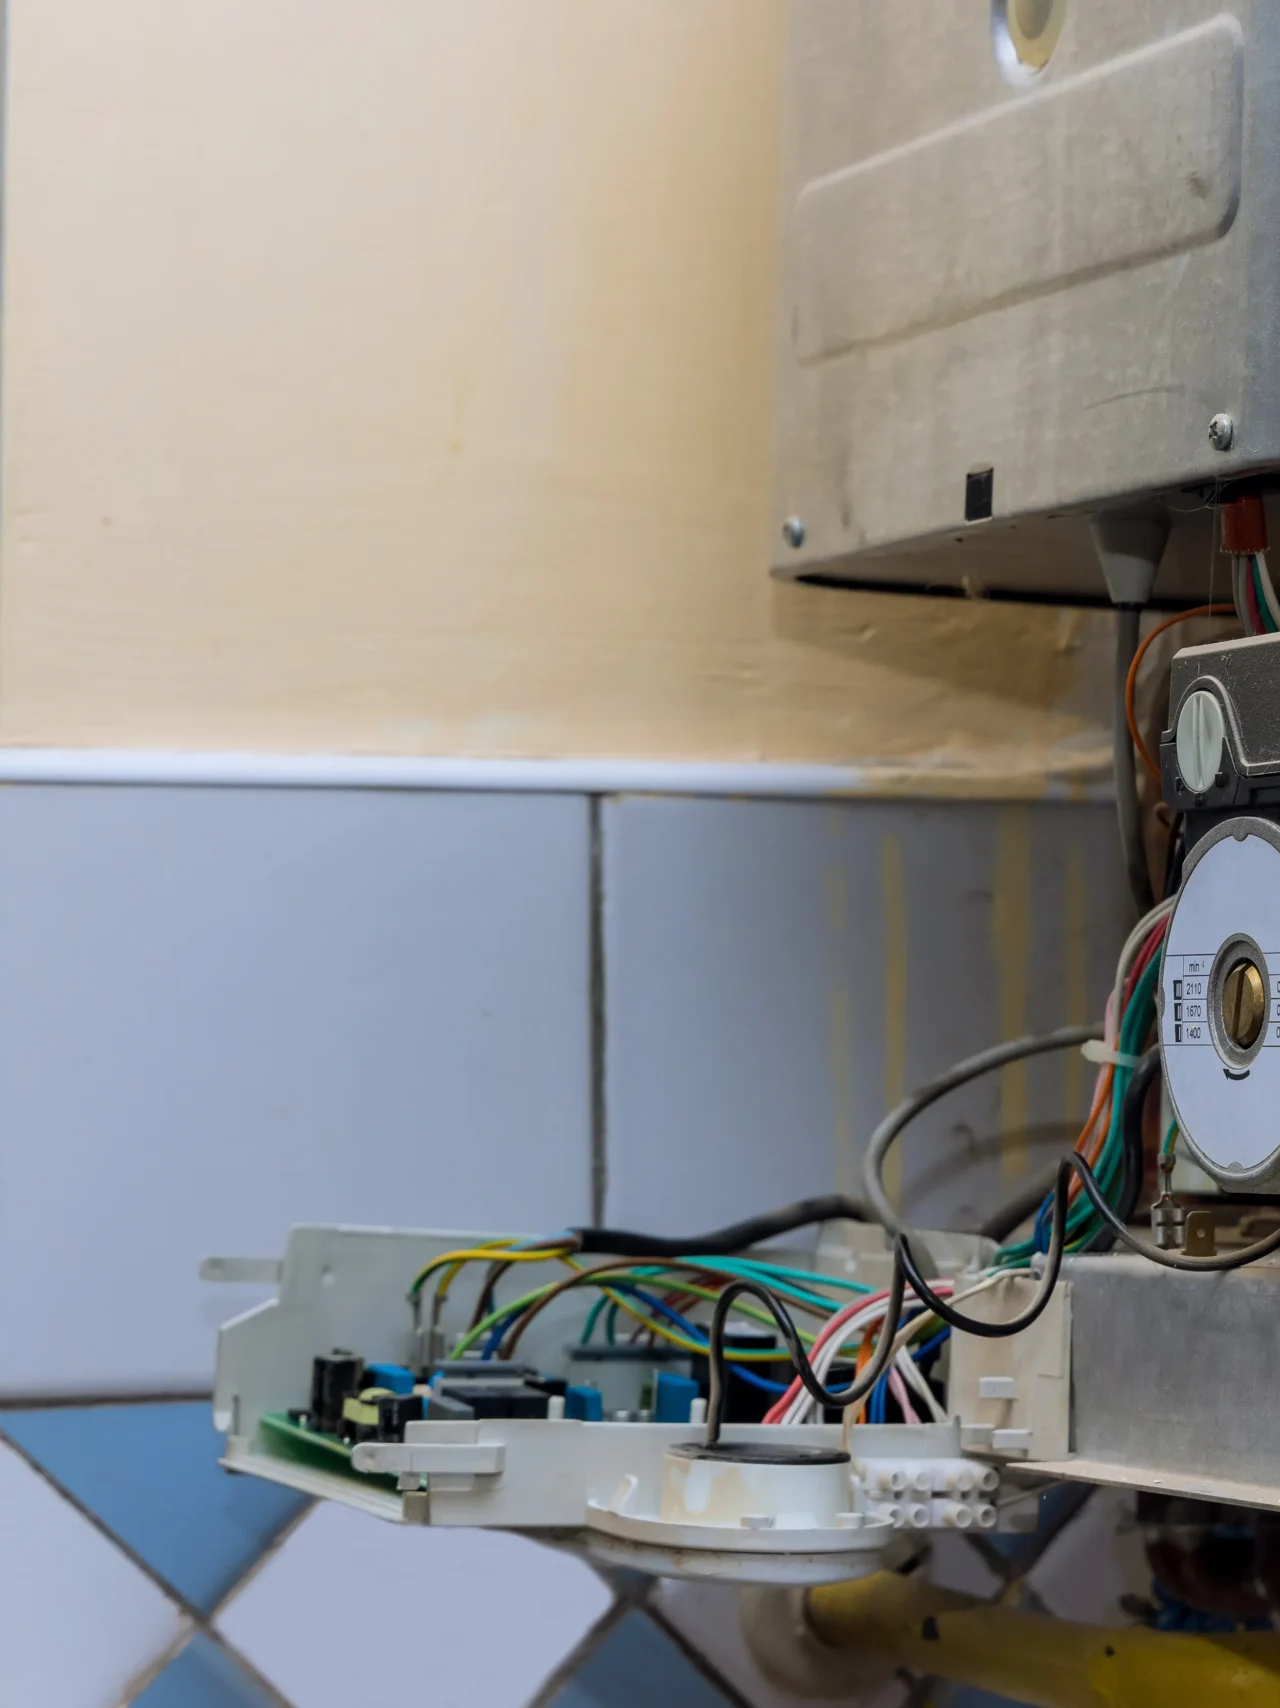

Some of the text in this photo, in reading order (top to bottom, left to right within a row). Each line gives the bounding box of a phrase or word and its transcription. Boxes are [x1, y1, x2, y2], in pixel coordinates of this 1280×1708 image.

[1186, 983, 1202, 995] 2110
[1186, 1005, 1202, 1017] 1670
[1185, 1027, 1201, 1039] 1400
